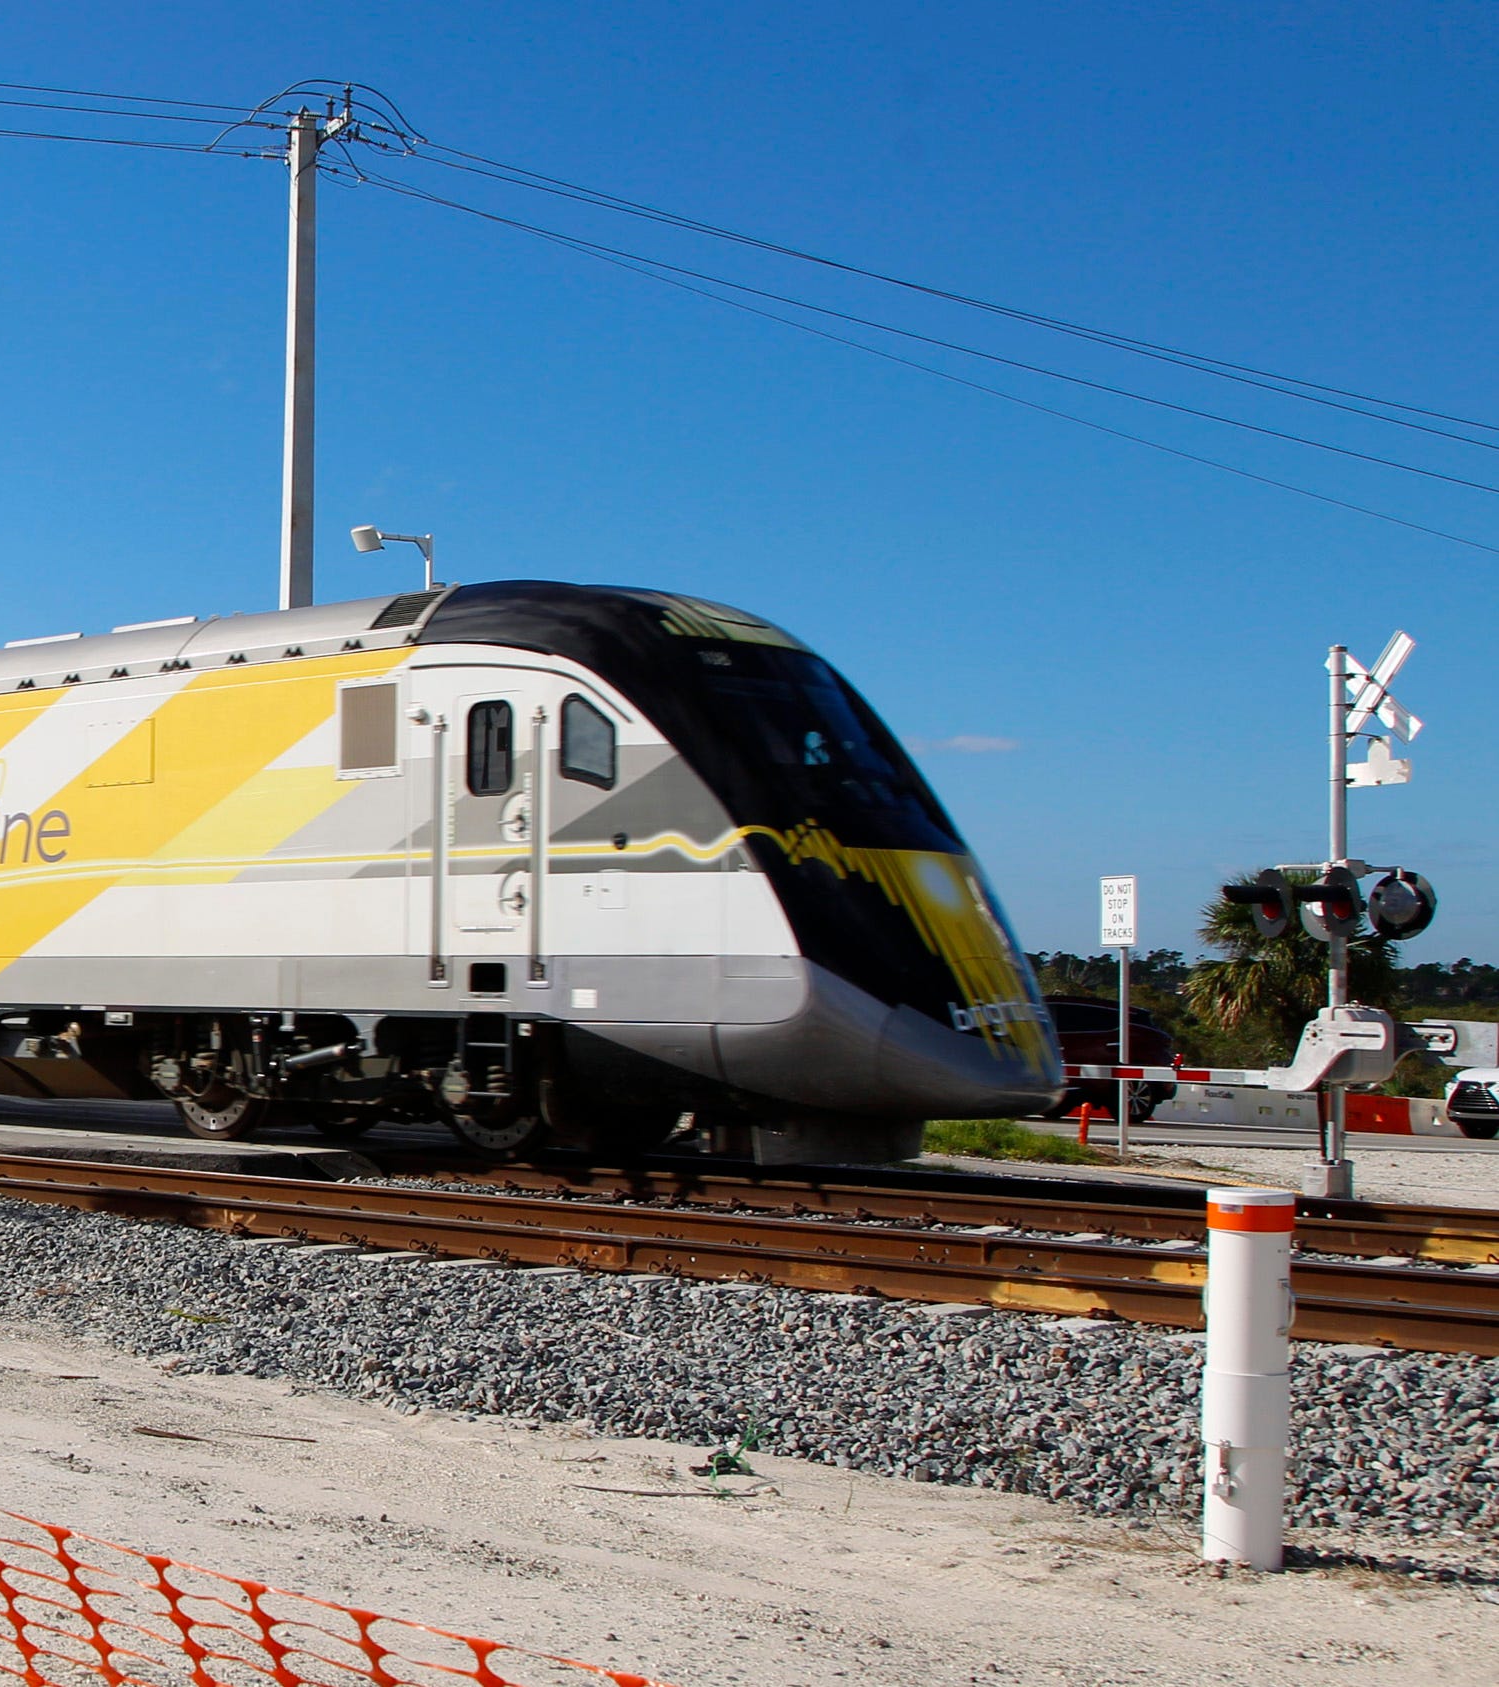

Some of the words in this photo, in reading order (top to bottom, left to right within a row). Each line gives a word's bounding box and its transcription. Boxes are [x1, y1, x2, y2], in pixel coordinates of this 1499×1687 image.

[1103, 885, 1115, 895] DO
[1117, 883, 1132, 895] NOT
[1108, 898, 1128, 910] STOP
[1112, 913, 1124, 924] ON
[1103, 928, 1133, 938] TRACKS
